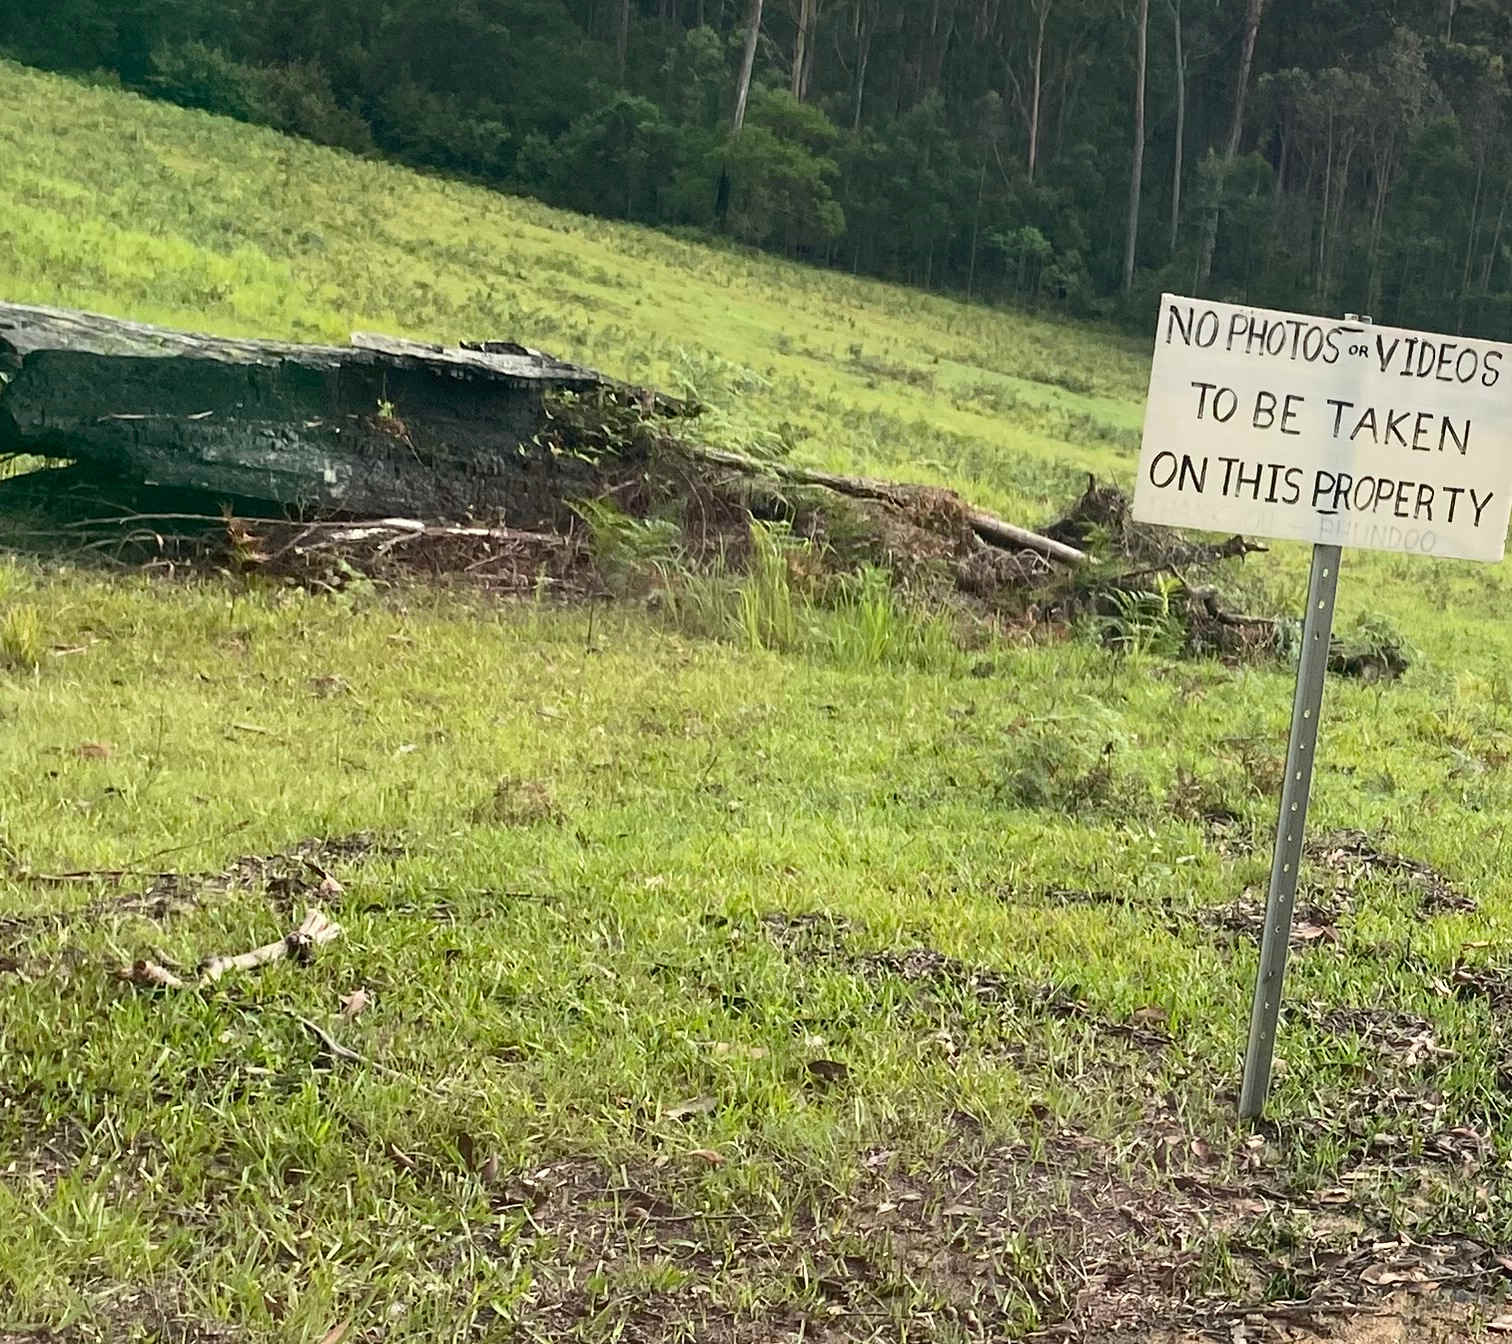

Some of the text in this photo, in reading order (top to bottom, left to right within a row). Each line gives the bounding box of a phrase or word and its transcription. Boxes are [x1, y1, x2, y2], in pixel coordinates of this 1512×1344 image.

[1166, 305, 1503, 387] NO PHOTOS OR VIDEOS
[1190, 381, 1471, 455] TO BE TAKEN
[1149, 451, 1208, 493] ON
[1217, 456, 1303, 505] THIS
[1312, 471, 1494, 527] PROPERTY
